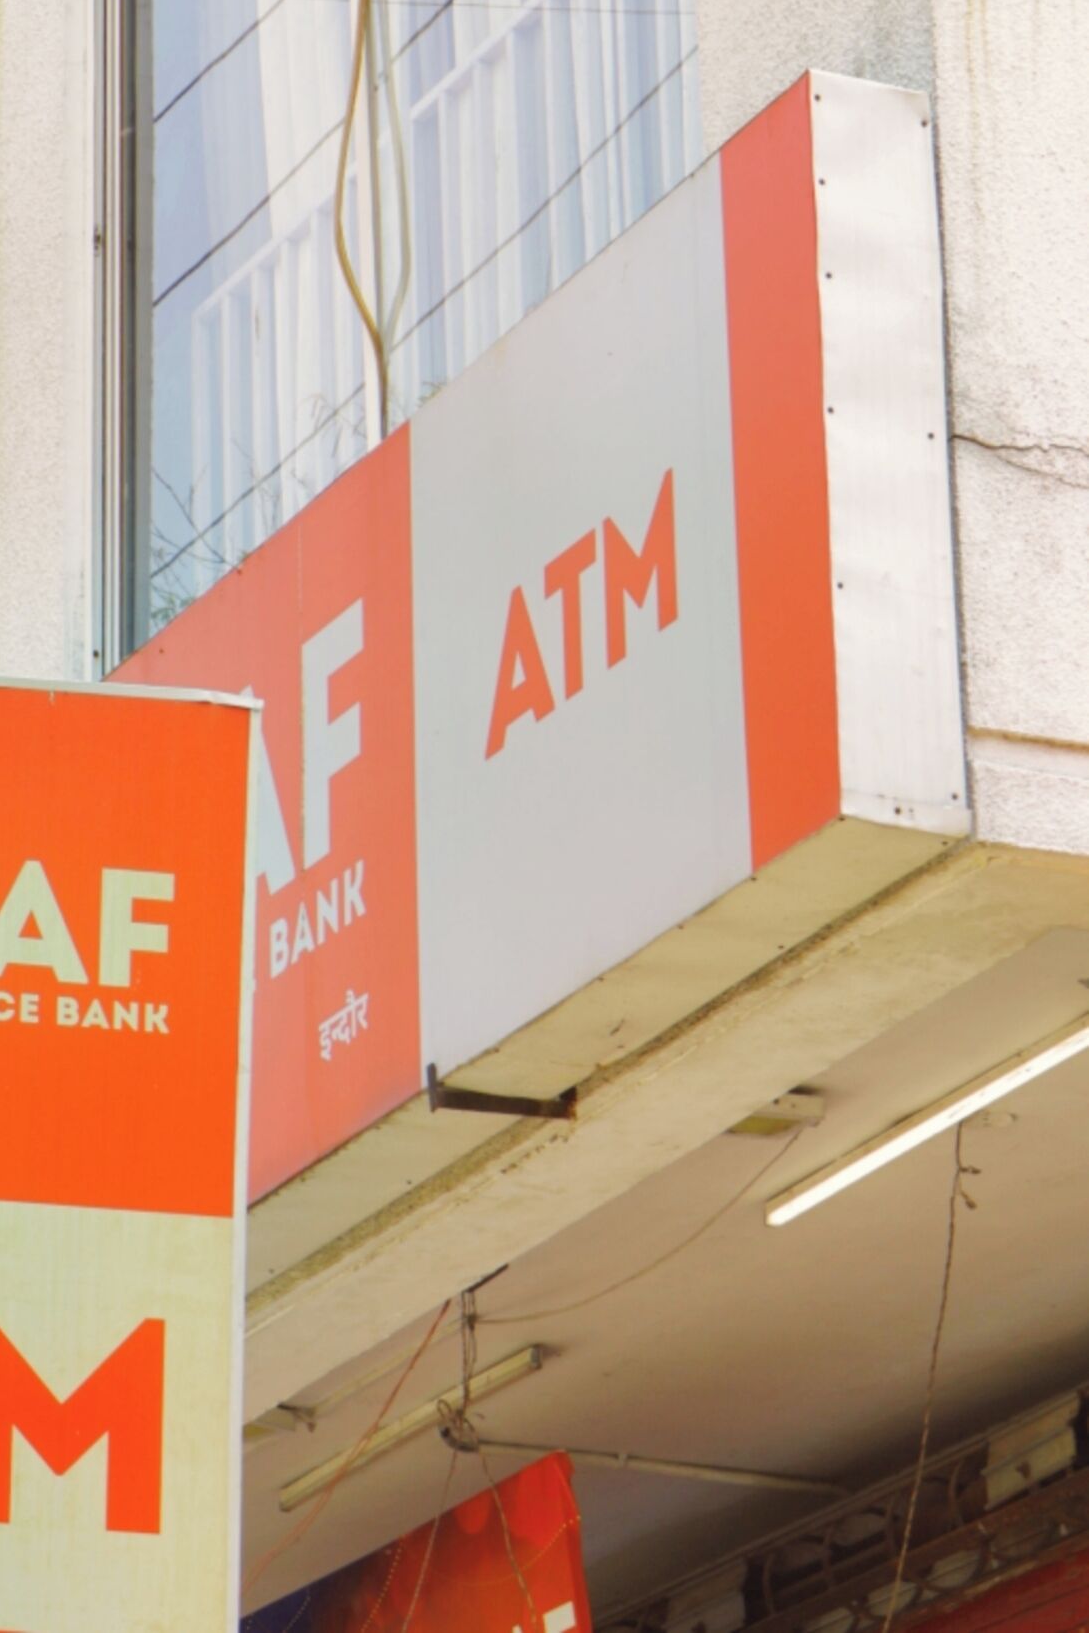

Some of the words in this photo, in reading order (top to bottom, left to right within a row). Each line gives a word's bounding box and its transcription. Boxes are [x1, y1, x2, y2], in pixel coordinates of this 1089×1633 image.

[485, 467, 679, 761] ATM
[269, 858, 367, 980] BANK
[56, 996, 170, 1035] BANK
